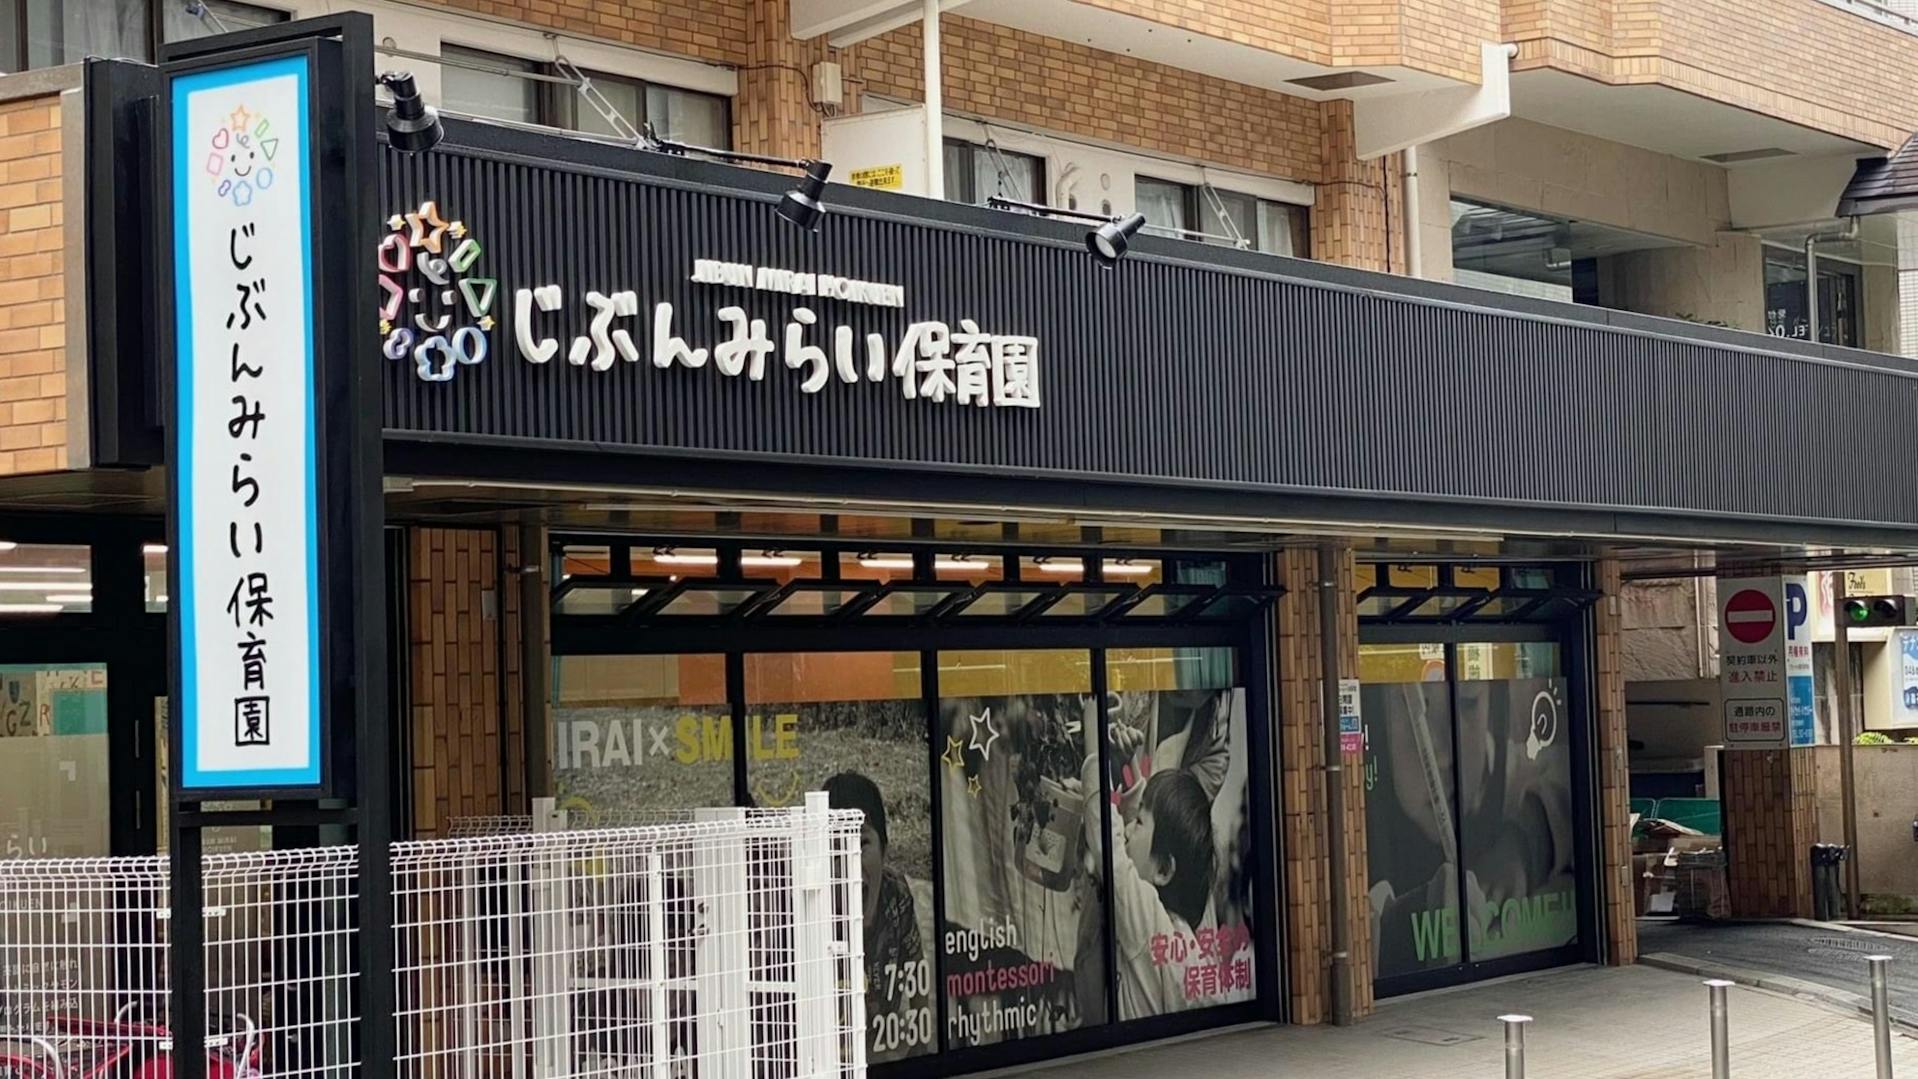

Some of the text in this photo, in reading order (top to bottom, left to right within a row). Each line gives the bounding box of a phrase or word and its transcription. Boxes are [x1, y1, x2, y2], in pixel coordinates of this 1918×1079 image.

[515, 283, 1041, 409] じぶんみらい保育園
[227, 223, 274, 746] じぶんみらい保育園
[1786, 583, 1807, 640] P
[1726, 654, 1778, 666] 契約車以外
[1728, 670, 1778, 684] 進入禁止
[1734, 706, 1776, 718] 通路内の
[945, 914, 1017, 962] english
[1411, 890, 1577, 962] WECOME!!
[885, 959, 931, 1001] 7:30
[947, 952, 1055, 999] montessori
[1184, 957, 1251, 1000] 保育体制
[872, 1006, 932, 1053] 20:30
[948, 996, 1037, 1046] rhythmic
